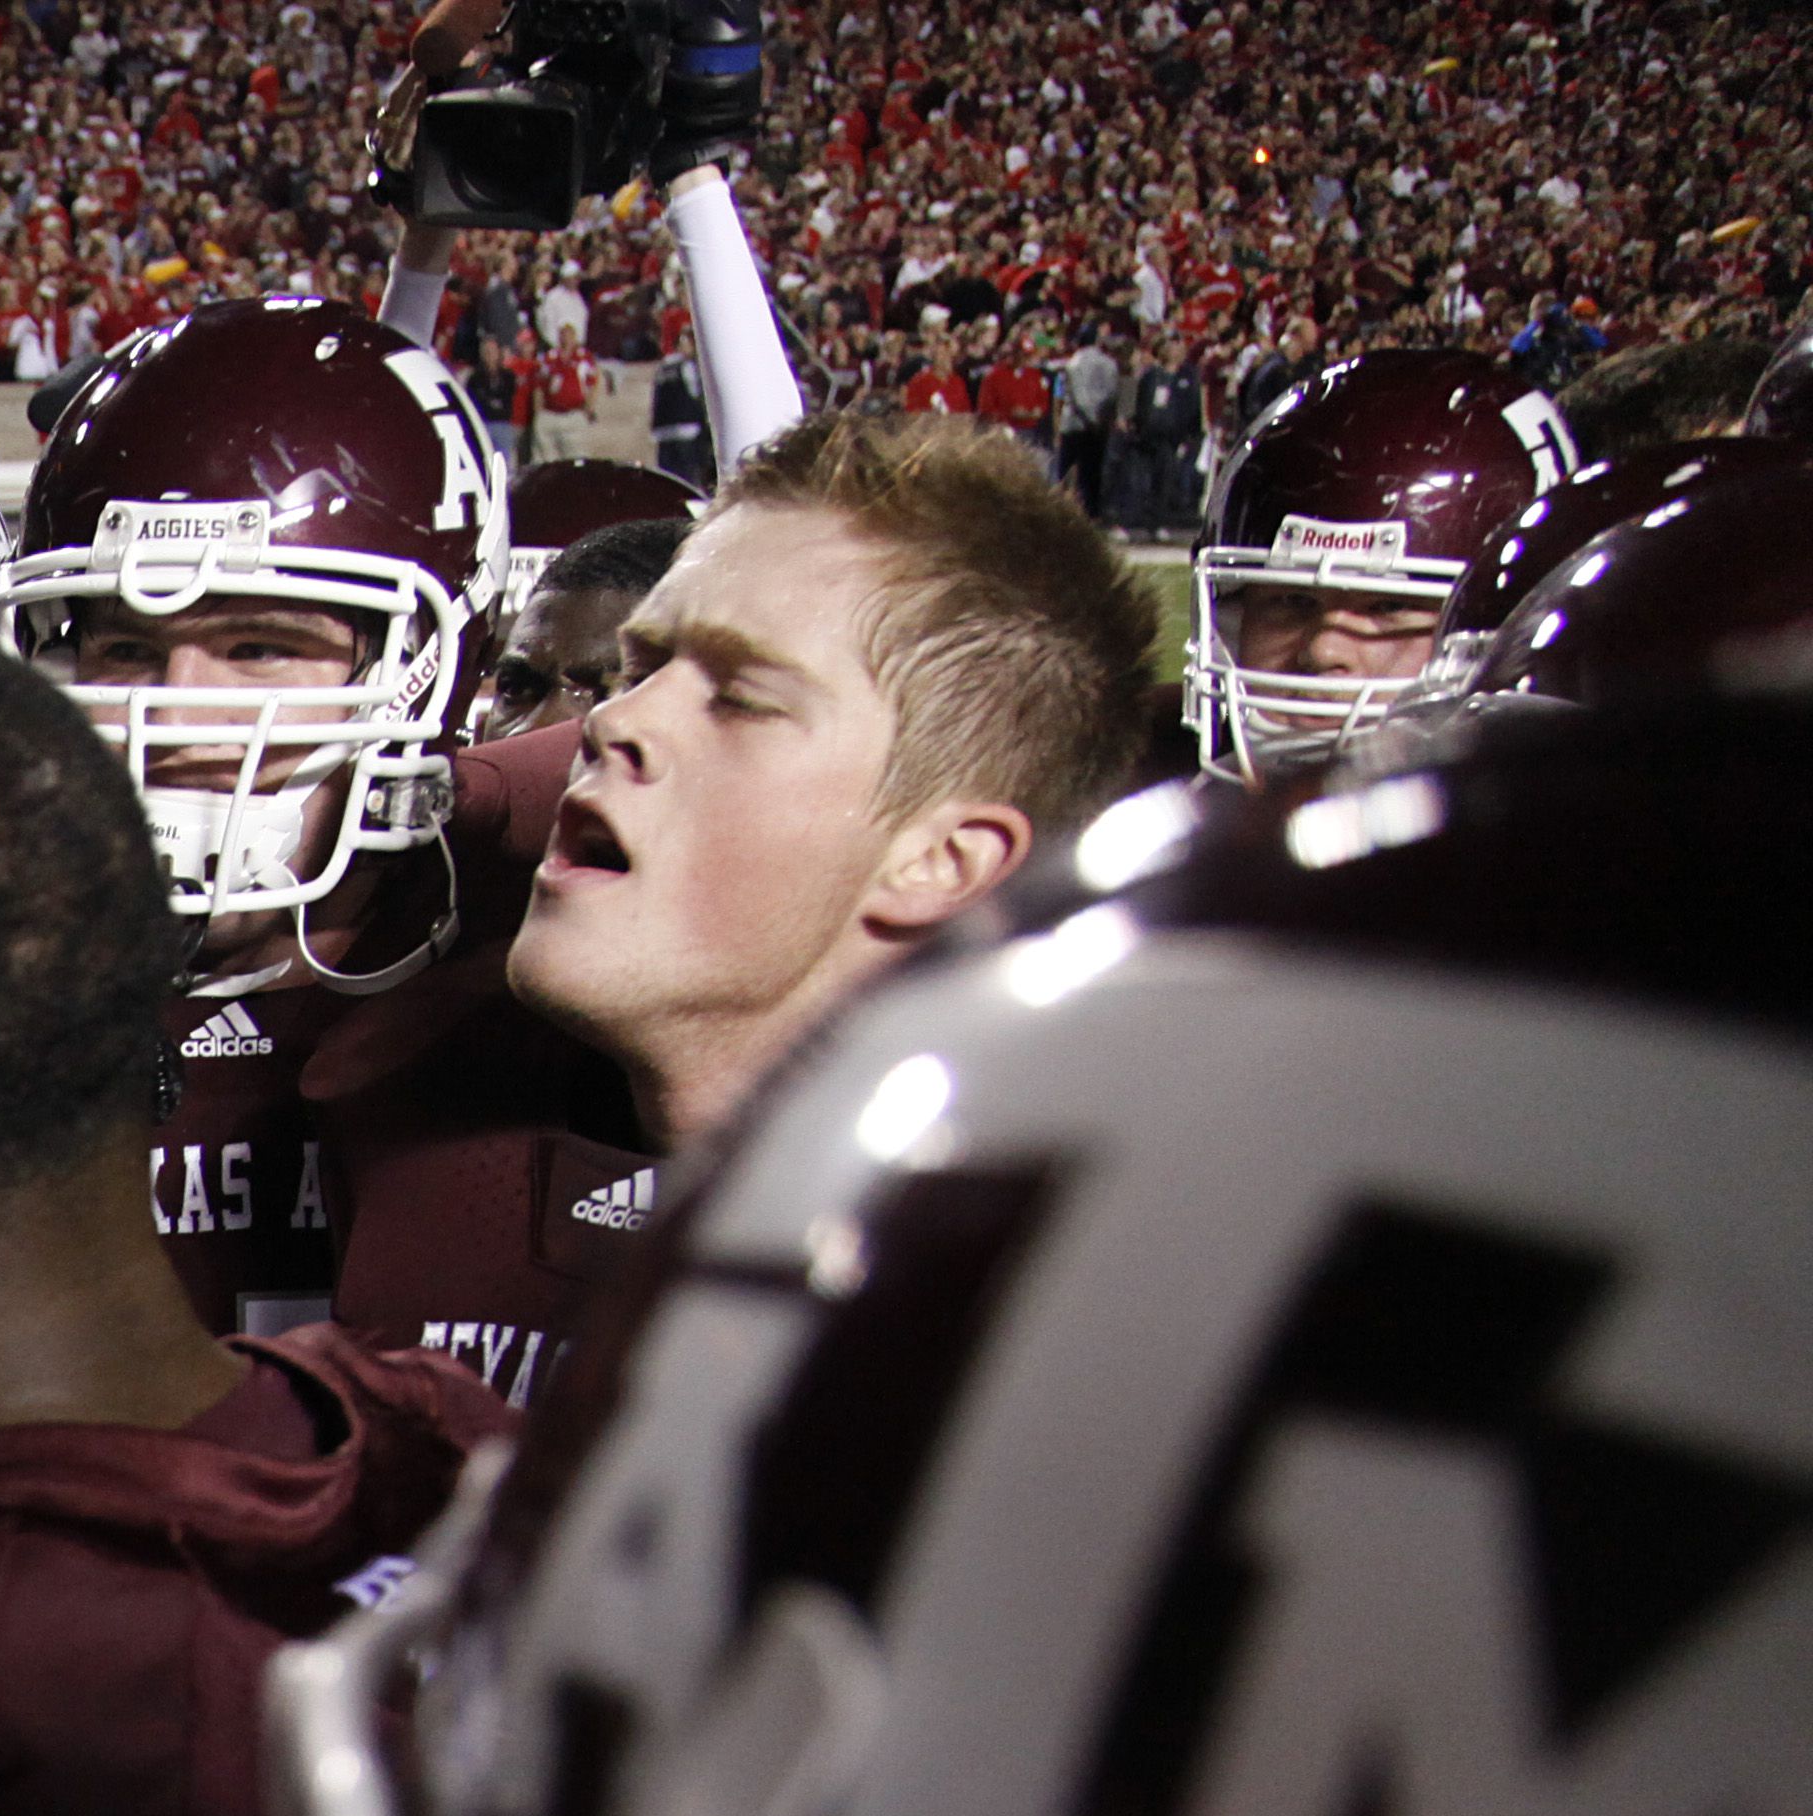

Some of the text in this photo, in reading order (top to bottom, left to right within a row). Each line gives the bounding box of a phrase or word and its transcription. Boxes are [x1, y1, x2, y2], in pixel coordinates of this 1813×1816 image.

[137, 518, 225, 541] AGGIES
[1302, 527, 1376, 551] Riddell
[180, 1034, 273, 1058] adidas
